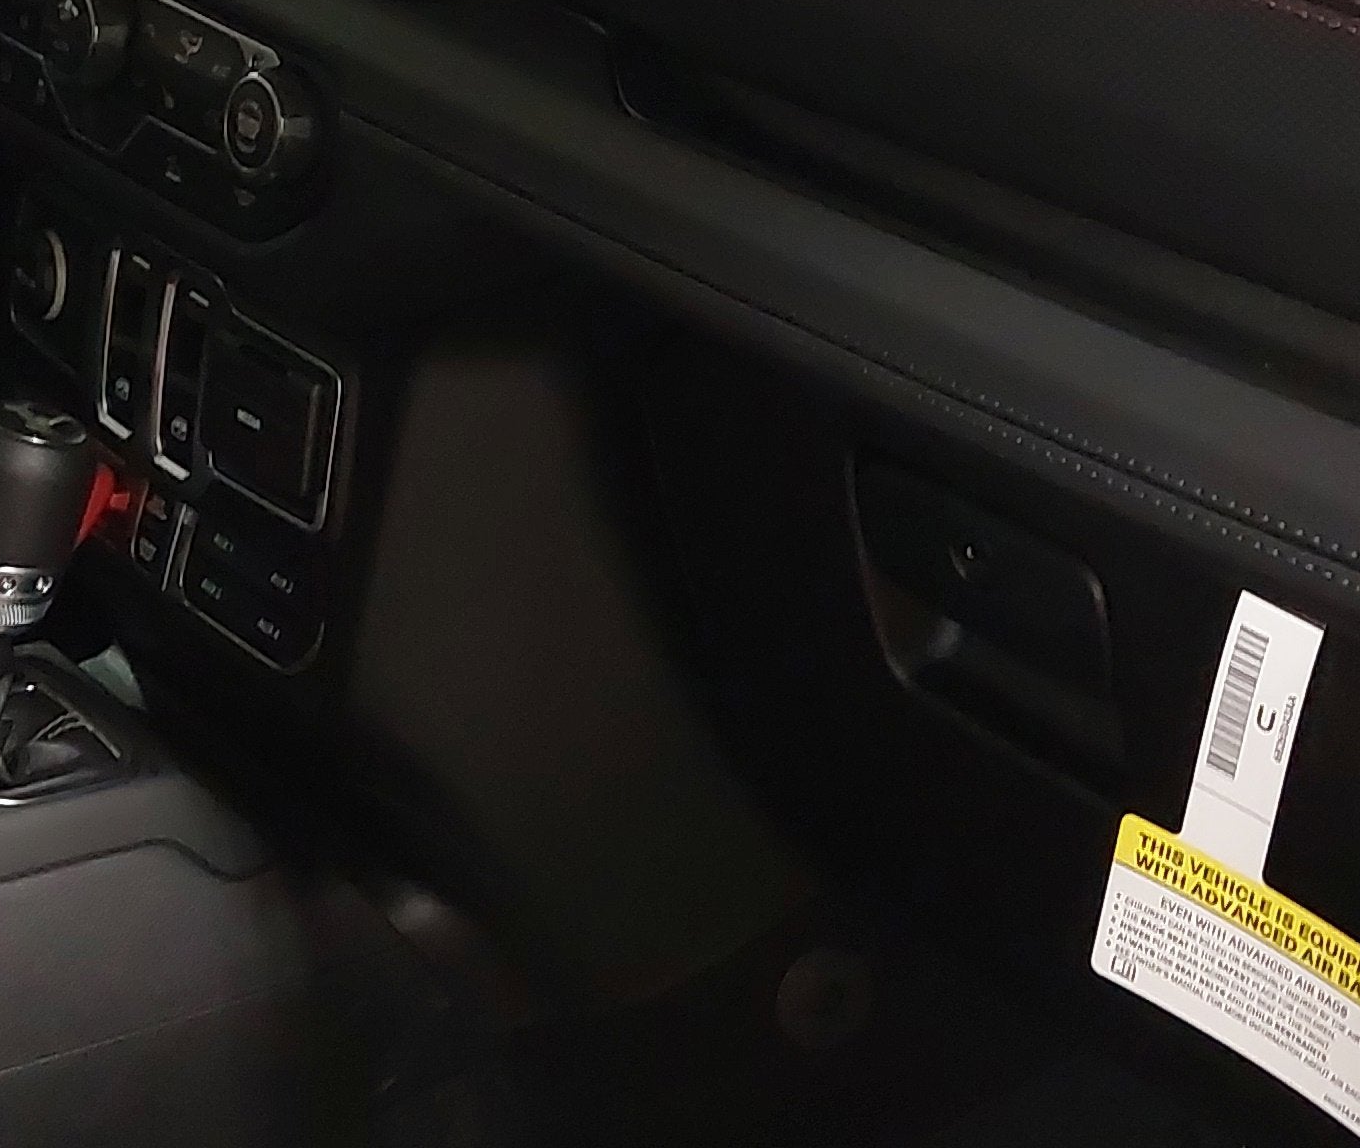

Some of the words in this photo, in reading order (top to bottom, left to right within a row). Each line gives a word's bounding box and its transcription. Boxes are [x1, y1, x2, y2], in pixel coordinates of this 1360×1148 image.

[1256, 703, 1277, 732] U
[1133, 848, 1187, 890] WITH
[1190, 878, 1298, 955] ADVANCED
[1300, 944, 1334, 978] AIR
[1137, 830, 1185, 868] THIS
[1187, 855, 1272, 918] VEHICLE
[1274, 905, 1294, 931] IS
[1159, 894, 1193, 923] EVEN
[1194, 913, 1226, 942] WITH
[1227, 932, 1293, 983] ADVANCED
[1294, 973, 1315, 997] AIR
[1316, 987, 1349, 1020] BAGS
